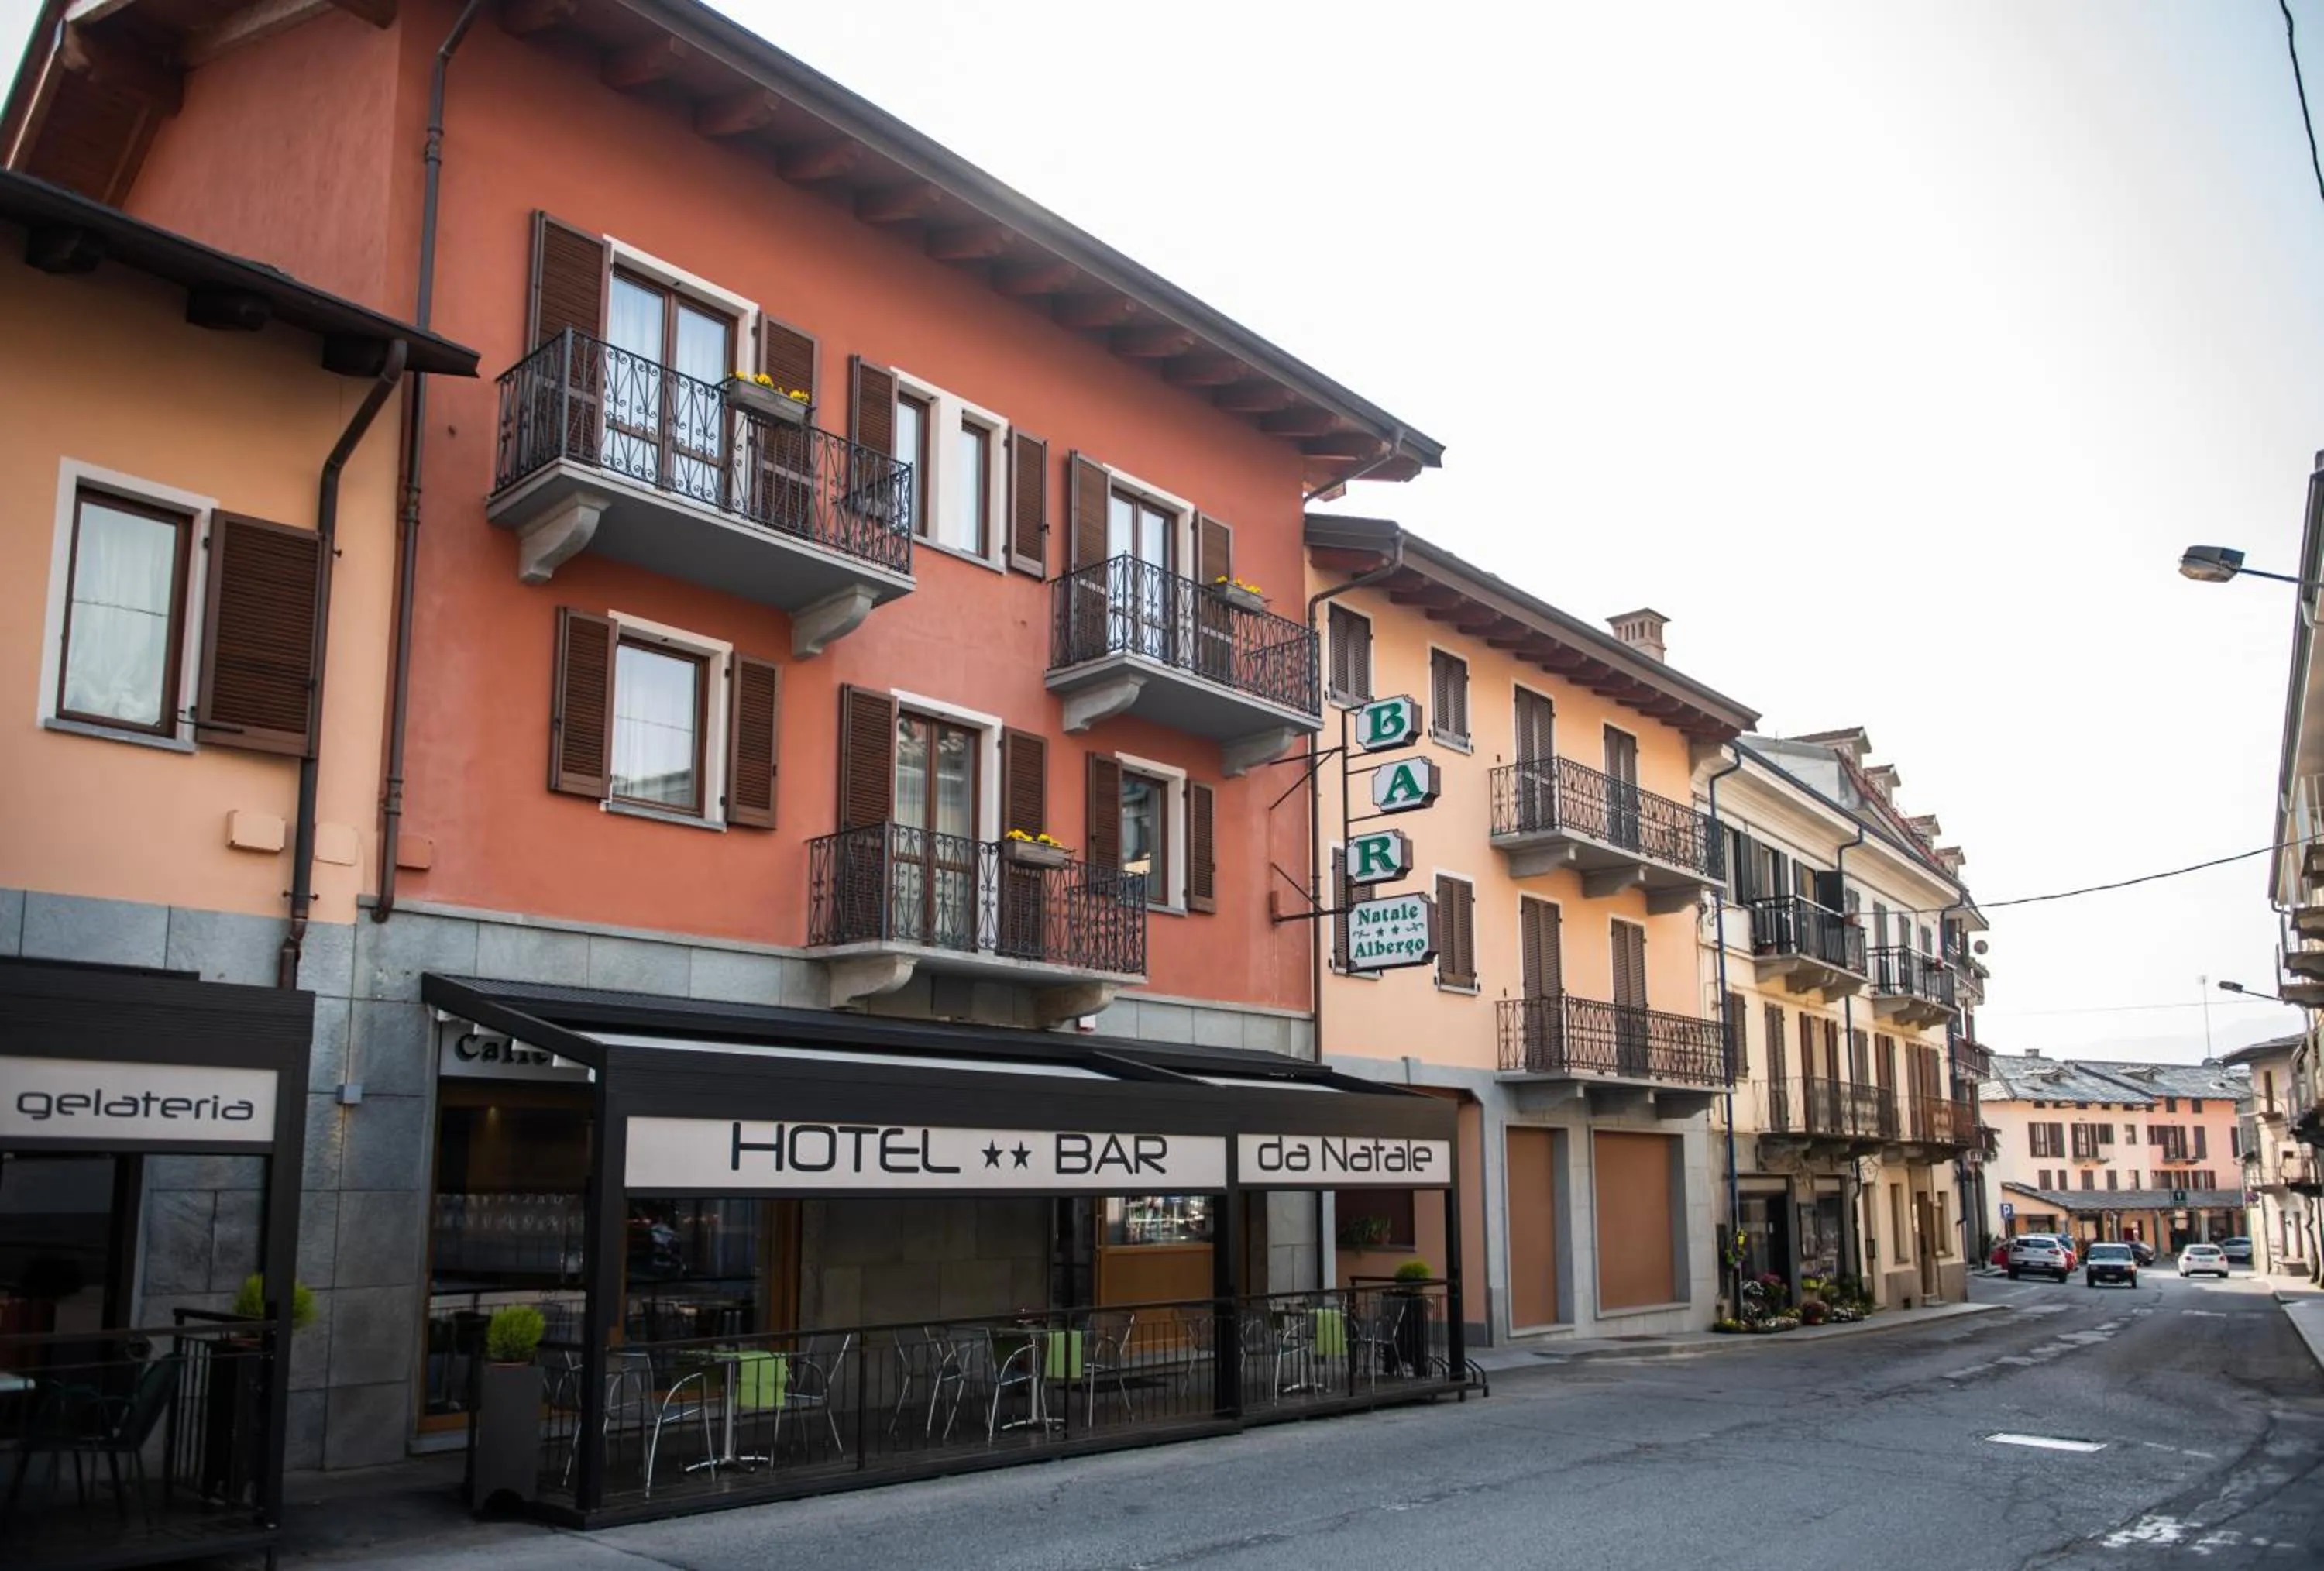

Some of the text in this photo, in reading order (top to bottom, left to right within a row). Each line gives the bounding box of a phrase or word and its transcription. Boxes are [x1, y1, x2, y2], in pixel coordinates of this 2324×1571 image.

[1357, 902, 1418, 926] Natale
[1354, 938, 1425, 957] Albergo
[16, 1088, 254, 1120] gelateria
[731, 1121, 1168, 1175] HOTEL BAR
[1257, 1135, 1432, 1172] da Natale
[2003, 1205, 2010, 1217] P
